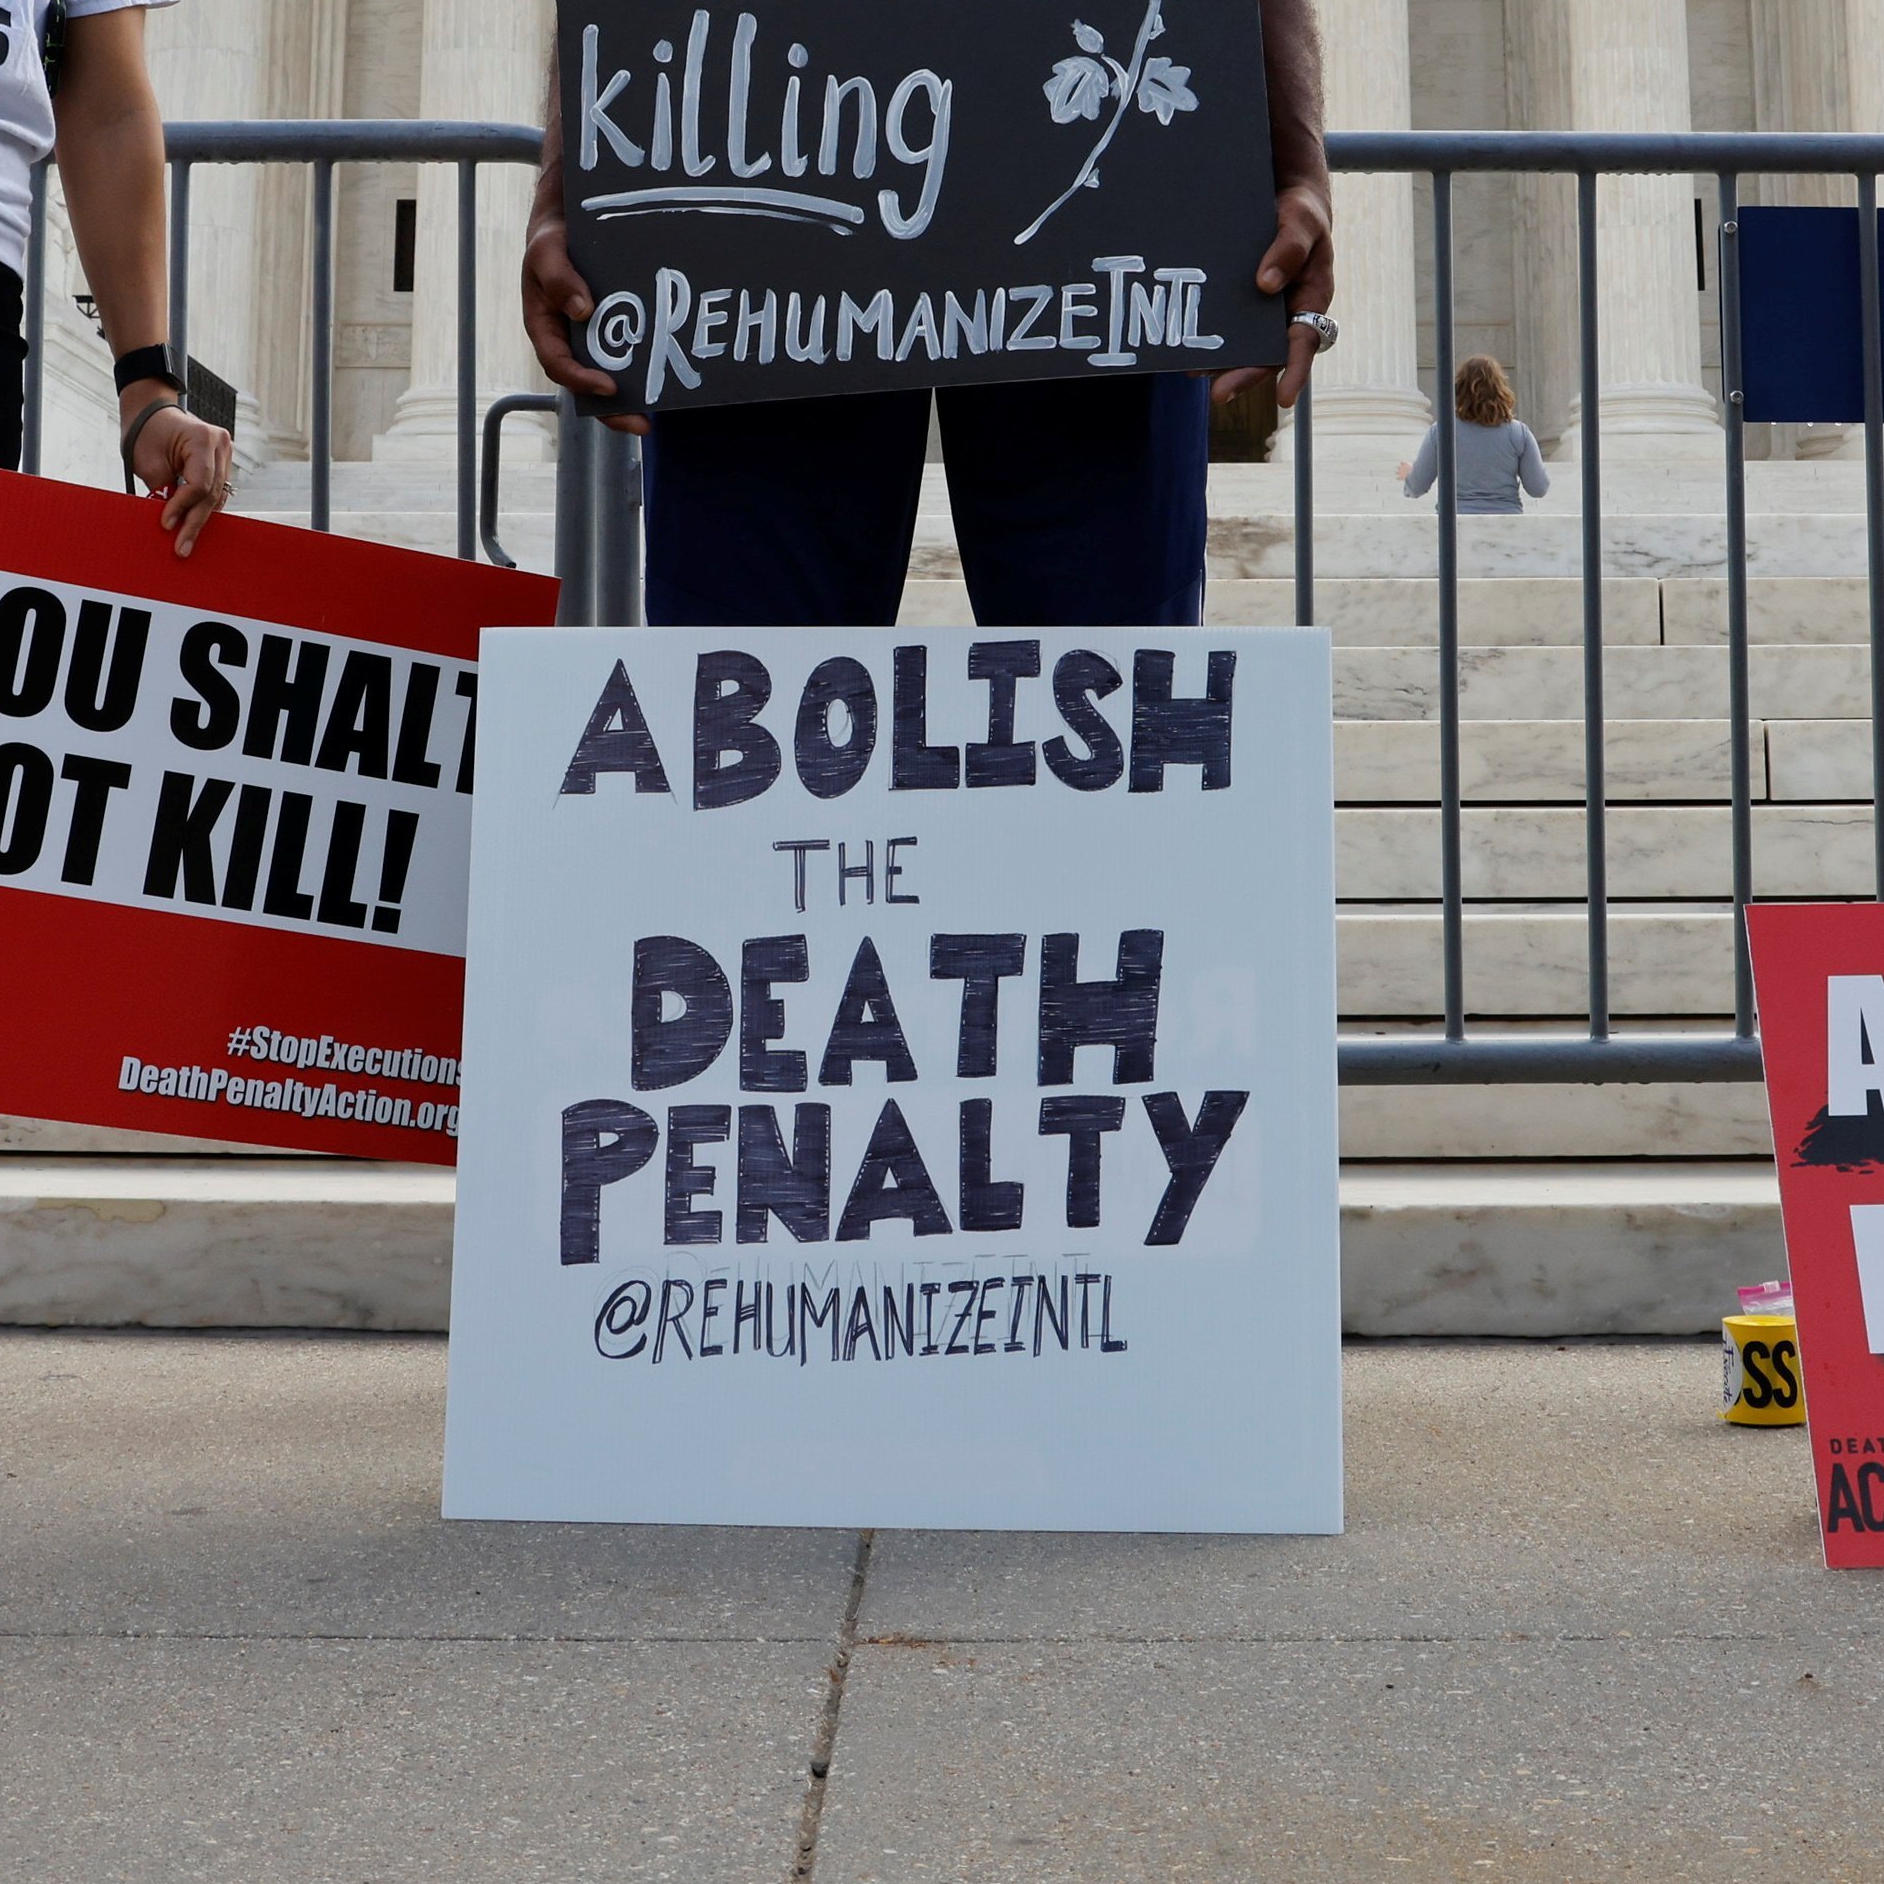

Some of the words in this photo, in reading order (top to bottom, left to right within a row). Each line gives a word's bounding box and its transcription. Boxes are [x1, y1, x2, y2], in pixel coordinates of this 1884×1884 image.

[580, 9, 952, 240] killing
[558, 638, 1237, 811] ABOLISH
[143, 770, 420, 935] KILL!
[773, 836, 919, 913] THE
[630, 929, 1165, 1093] DEATH
[118, 1056, 460, 1138] DeathPenaltyAction.org
[560, 1089, 1250, 1266] PENALTY
[594, 1273, 1128, 1366] @REHUMANIZEINTL
